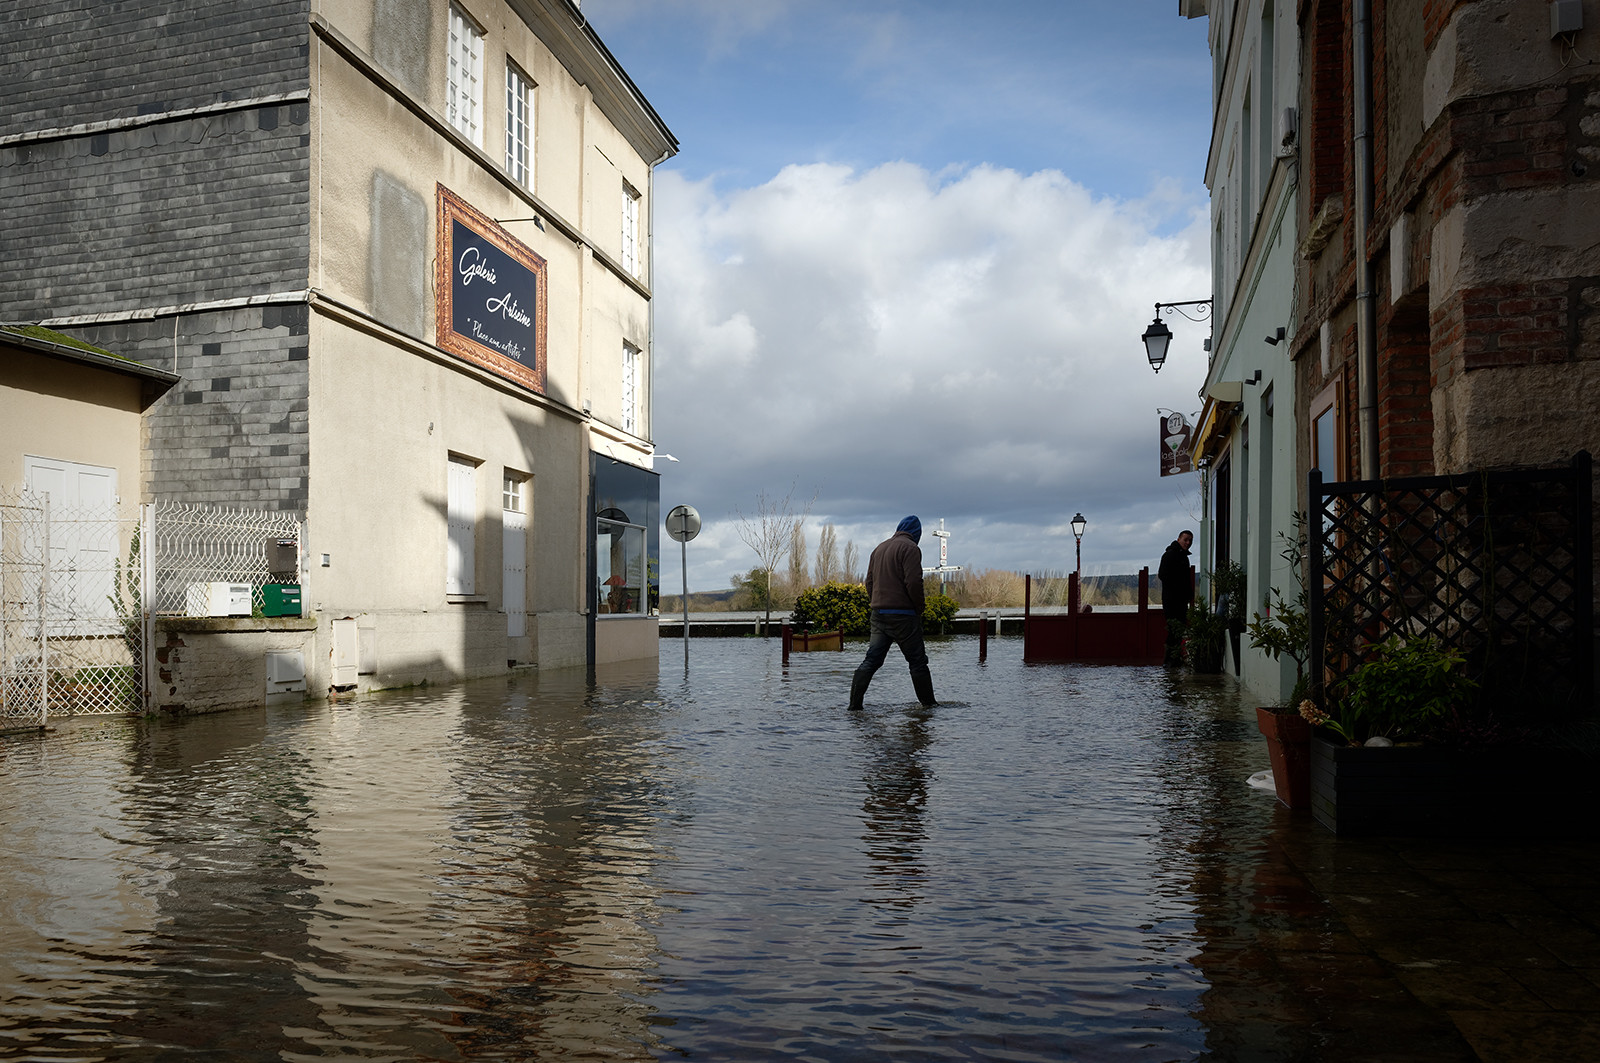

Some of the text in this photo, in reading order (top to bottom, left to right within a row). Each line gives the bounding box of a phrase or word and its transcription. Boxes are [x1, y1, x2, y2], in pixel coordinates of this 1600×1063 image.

[459, 247, 497, 286] Galerie
[486, 292, 531, 328] Artseine
[472, 320, 489, 342] Place
[501, 340, 522, 360] artistes
